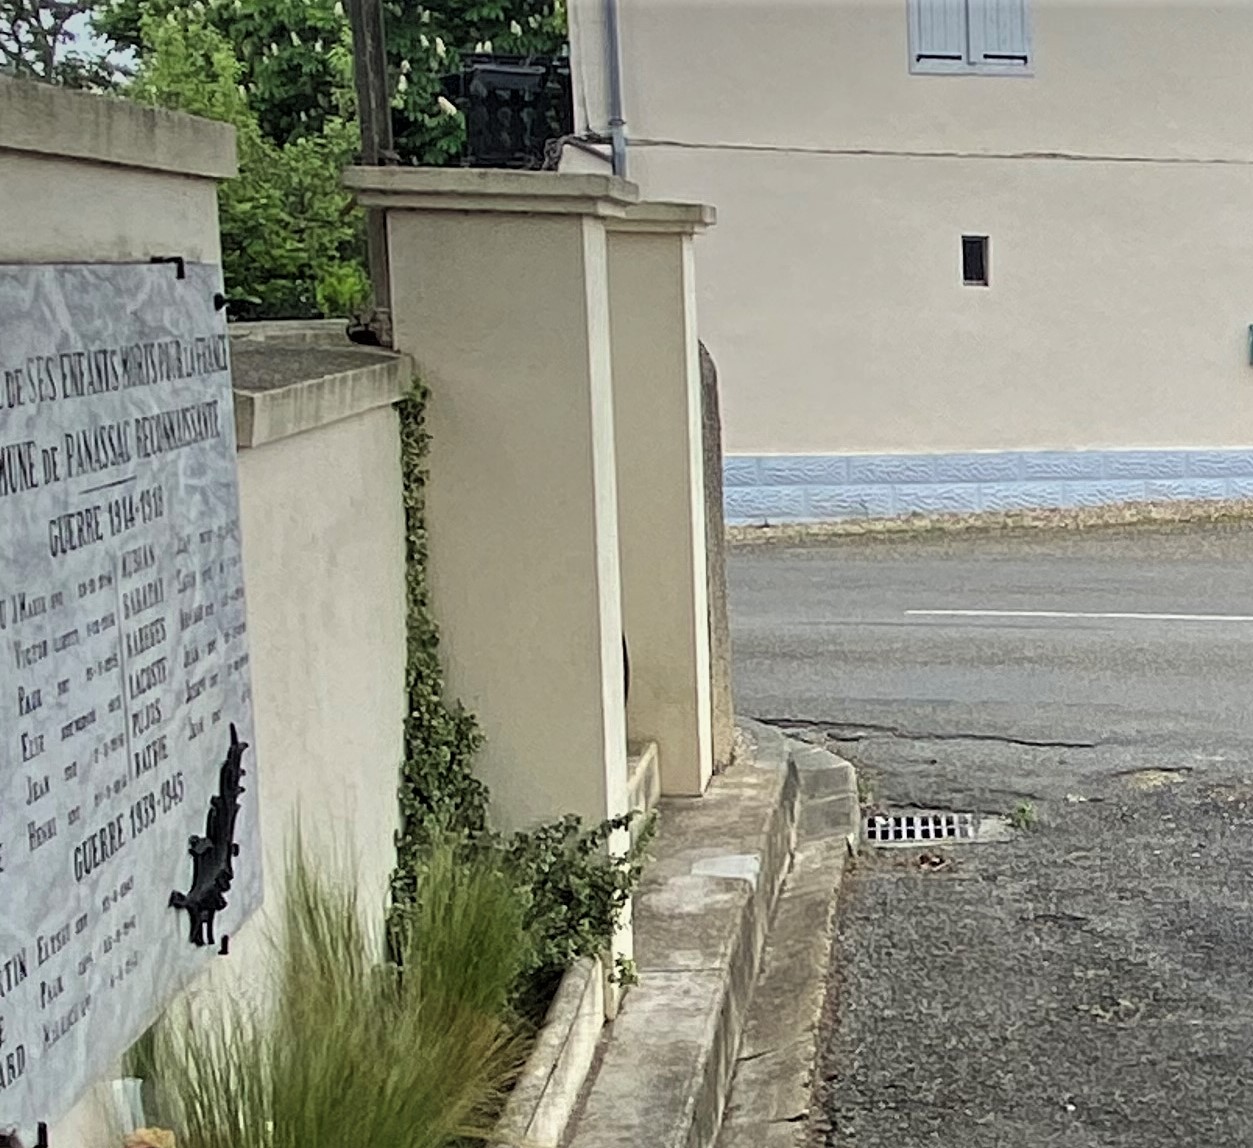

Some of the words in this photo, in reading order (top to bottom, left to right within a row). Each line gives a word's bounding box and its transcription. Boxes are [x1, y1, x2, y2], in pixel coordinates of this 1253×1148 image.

[5, 368, 25, 408] DE
[27, 355, 57, 403] SES
[60, 349, 119, 399] ENFANTS
[42, 446, 60, 485] DE
[64, 420, 130, 478] PANASSAC
[48, 505, 103, 557] GUERRE
[74, 812, 126, 882] GUERRE
[130, 769, 184, 839] 1939-1945
